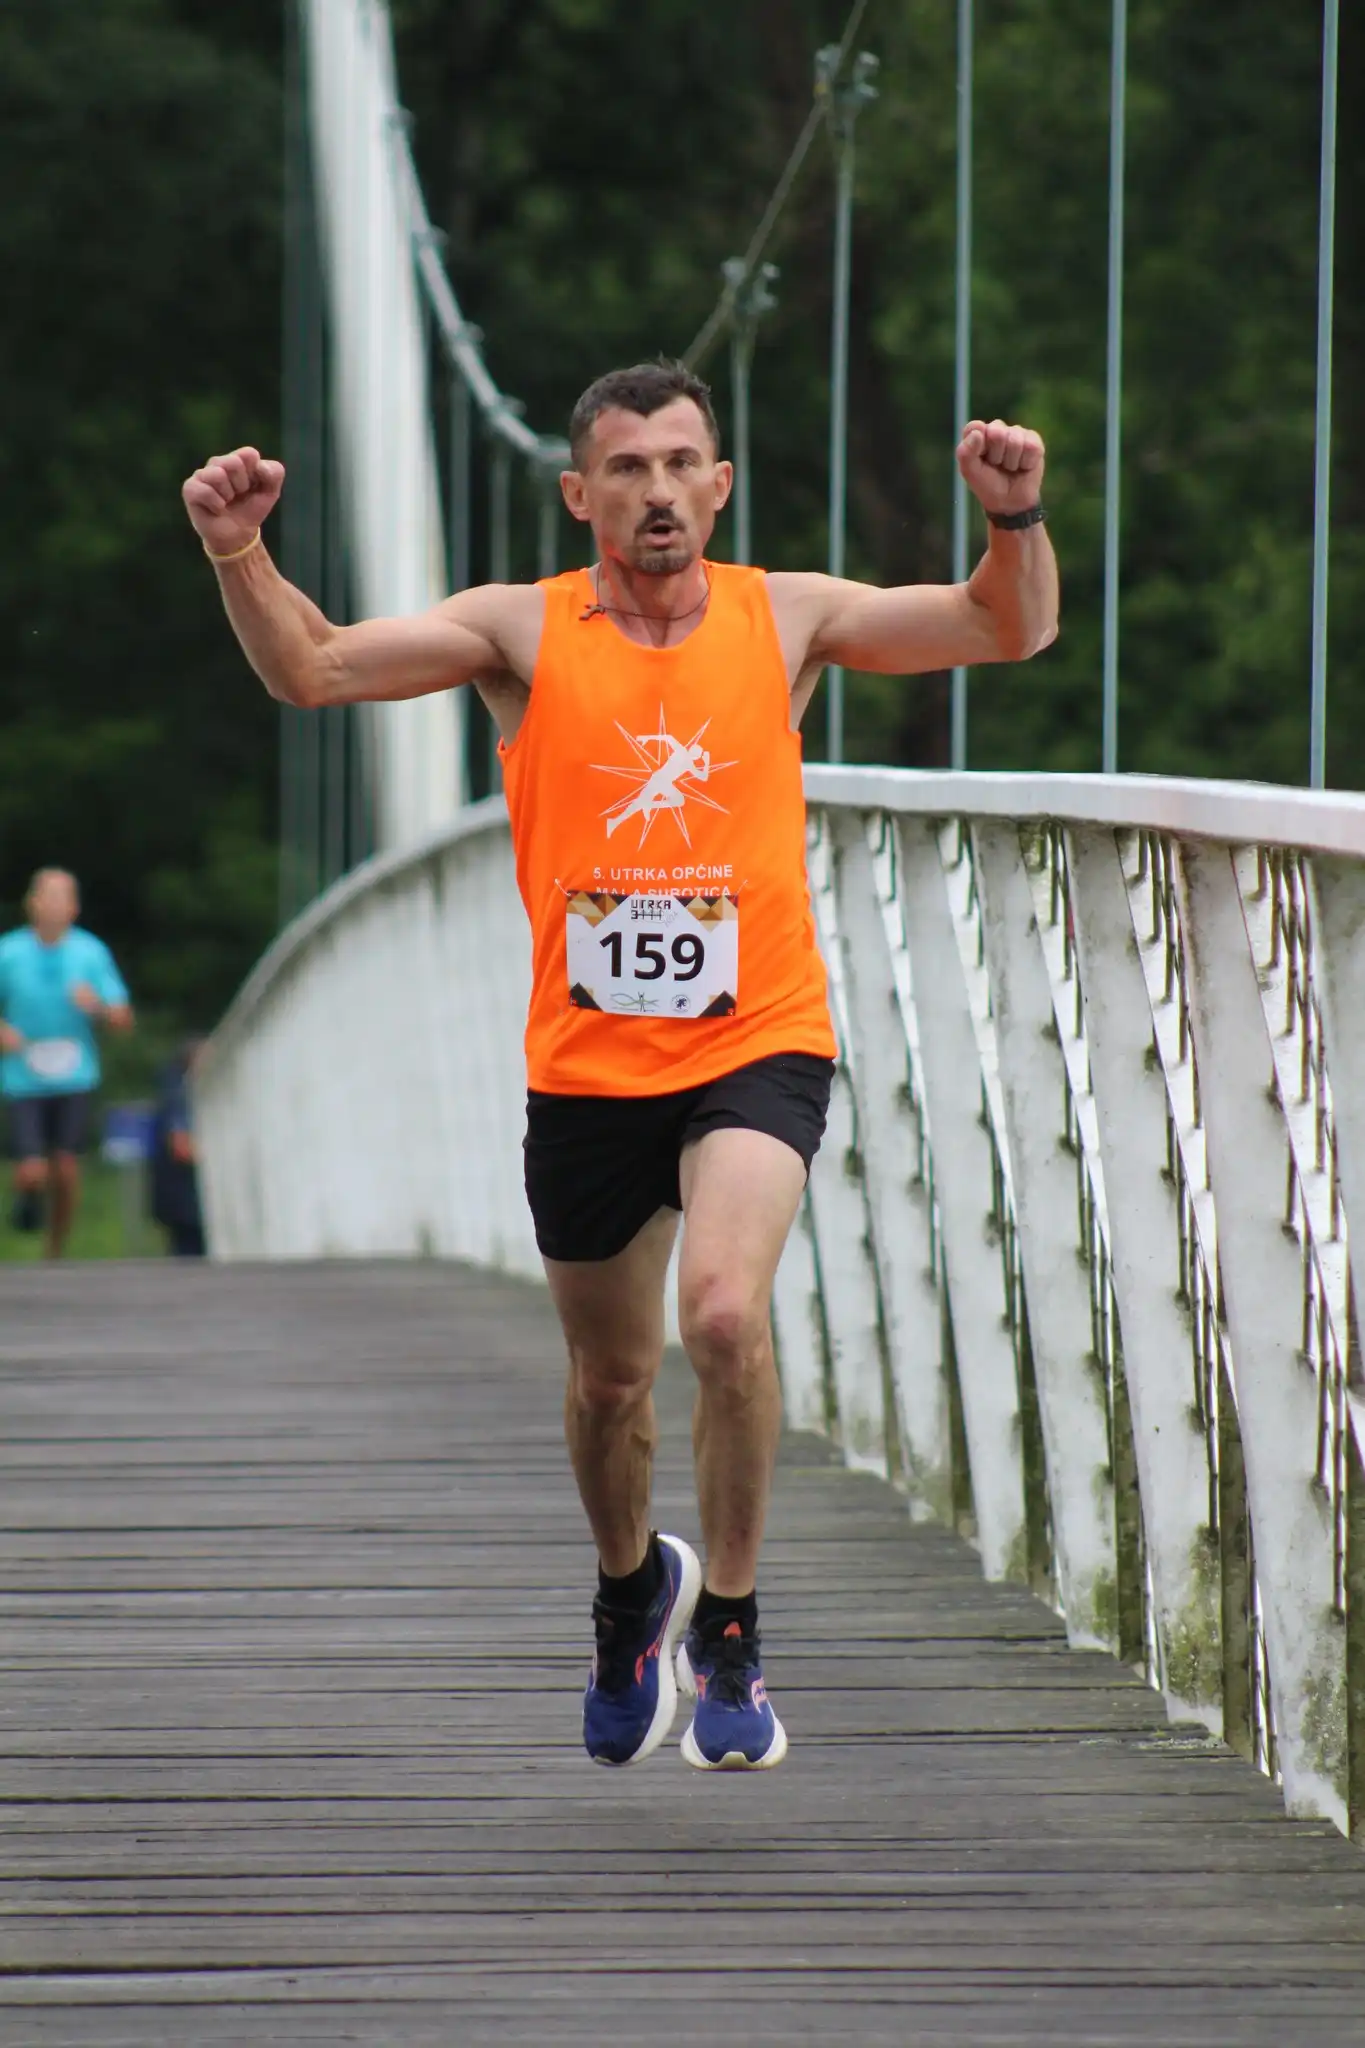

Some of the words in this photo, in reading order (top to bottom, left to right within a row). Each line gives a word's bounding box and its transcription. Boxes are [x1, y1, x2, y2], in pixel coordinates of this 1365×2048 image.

[593, 867, 606, 881] 5.
[611, 867, 668, 881] UTRKA
[672, 863, 733, 880] OPČINE
[631, 899, 672, 910] UTRKA
[599, 931, 705, 982] 159
